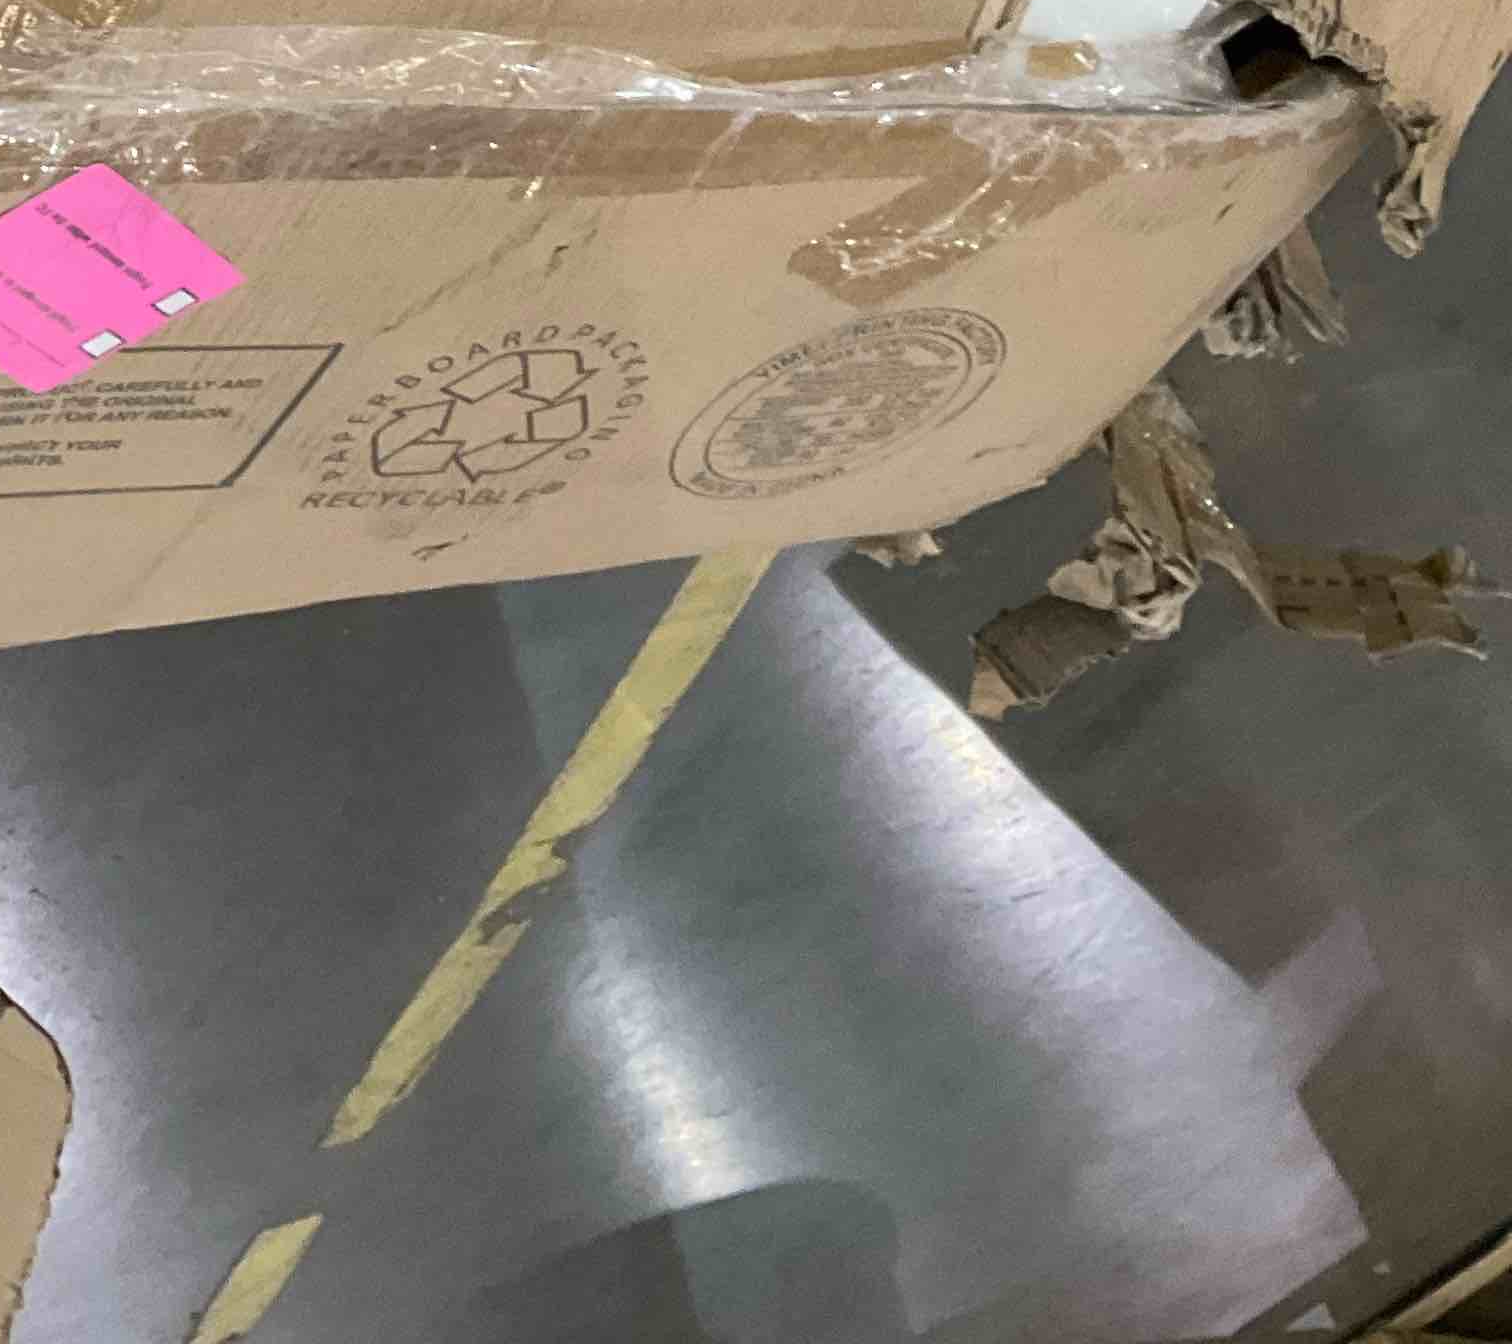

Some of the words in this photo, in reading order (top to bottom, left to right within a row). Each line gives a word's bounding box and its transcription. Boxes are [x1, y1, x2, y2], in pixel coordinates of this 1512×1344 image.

[95, 378, 217, 394] CAREFULLY
[217, 377, 265, 390] AND
[65, 438, 124, 453] YOUR
